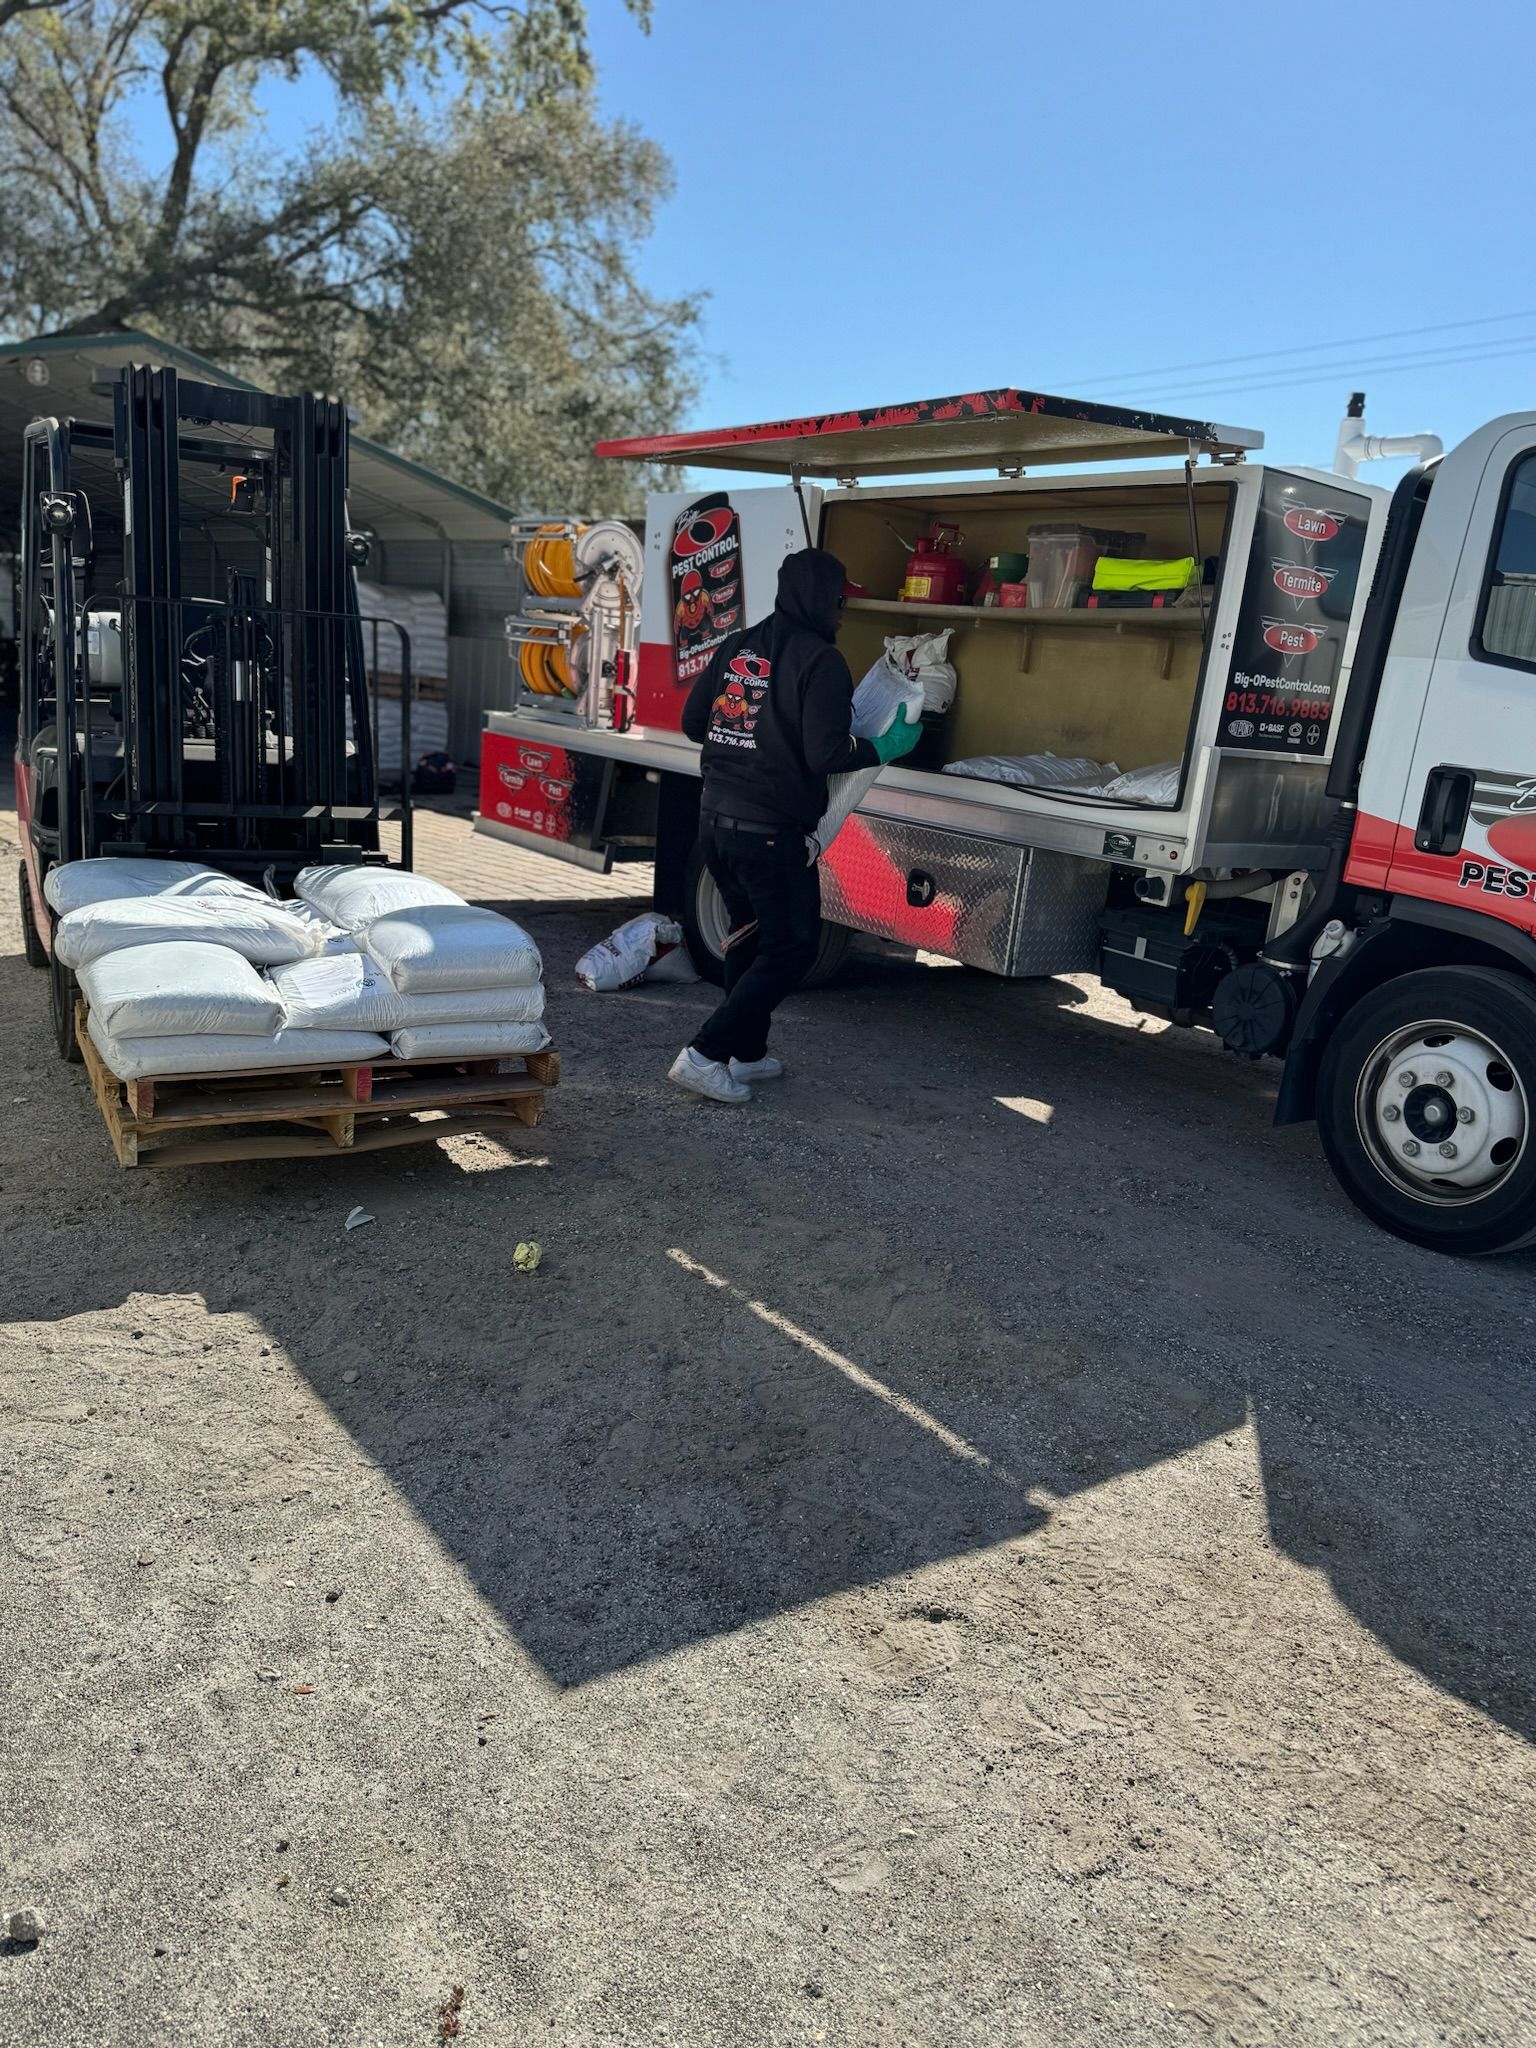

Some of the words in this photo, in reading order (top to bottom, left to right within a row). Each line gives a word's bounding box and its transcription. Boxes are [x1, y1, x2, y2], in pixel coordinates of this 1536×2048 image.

[1298, 514, 1326, 534] Lawn
[672, 556, 695, 579] PEST
[695, 534, 739, 567] CONTROL
[1283, 571, 1322, 593] Termite
[1280, 630, 1304, 648] Pest
[723, 671, 745, 684] PEST
[1233, 671, 1331, 695] Big-OPestControl.com
[1226, 690, 1330, 721] 813.716.9883
[1458, 860, 1536, 902] PES
